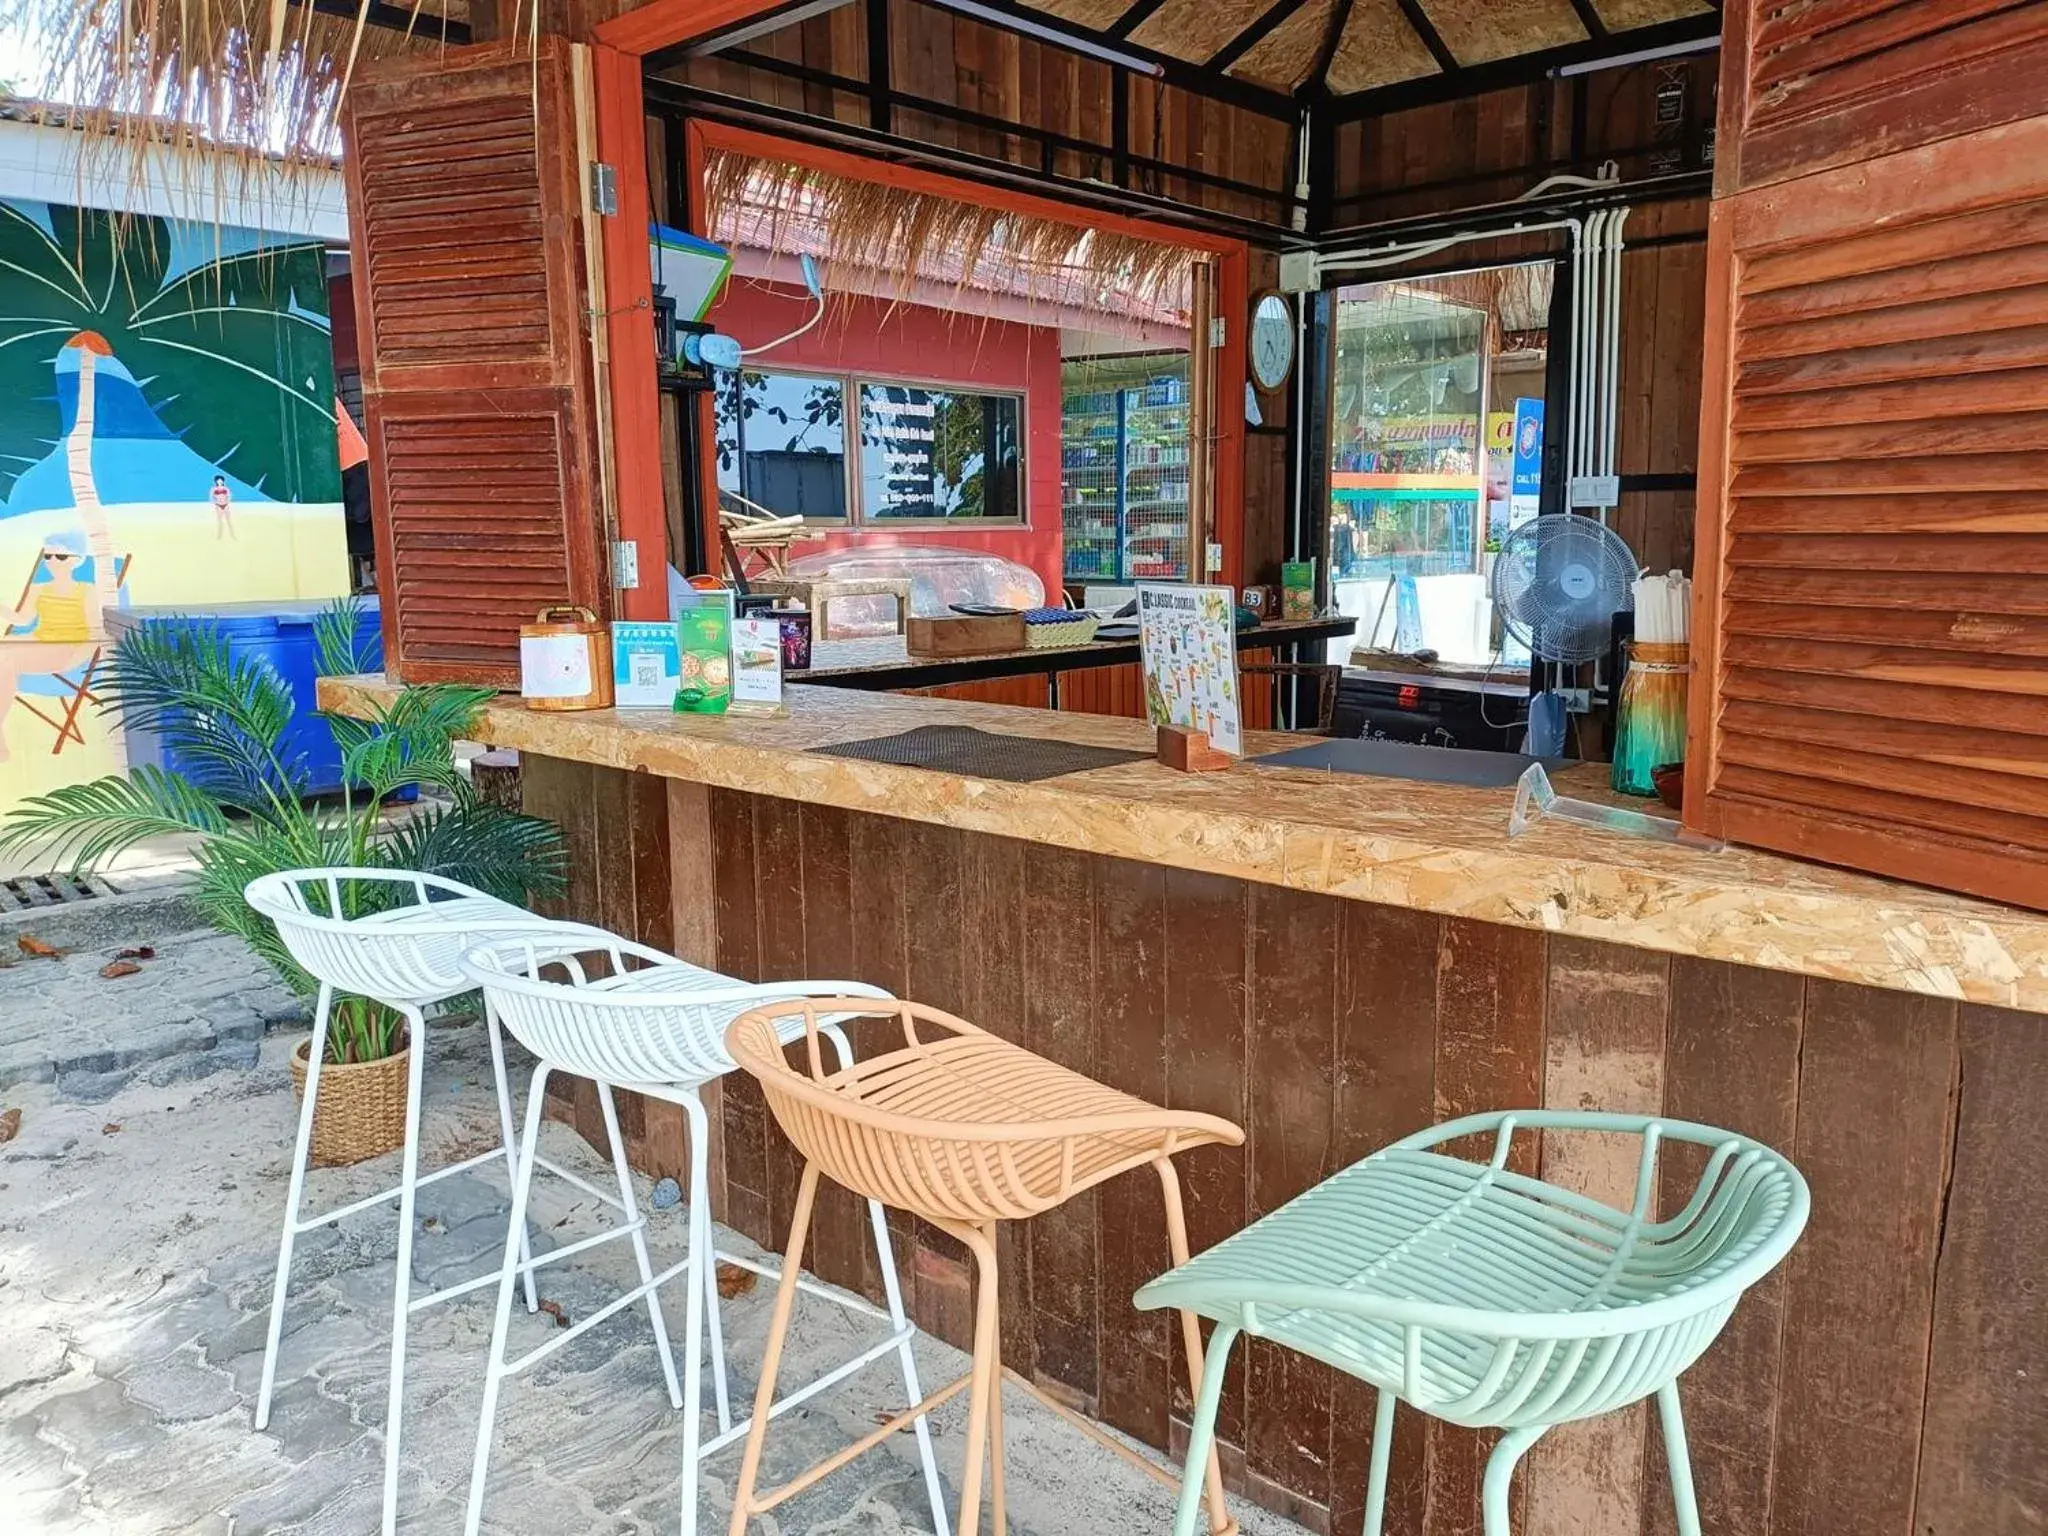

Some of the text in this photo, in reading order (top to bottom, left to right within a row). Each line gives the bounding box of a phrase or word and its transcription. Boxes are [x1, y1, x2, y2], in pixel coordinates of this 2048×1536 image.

[1516, 474, 1530, 484] CALL
[1149, 592, 1173, 608] CLASSIC
[1245, 592, 1259, 605] B3
